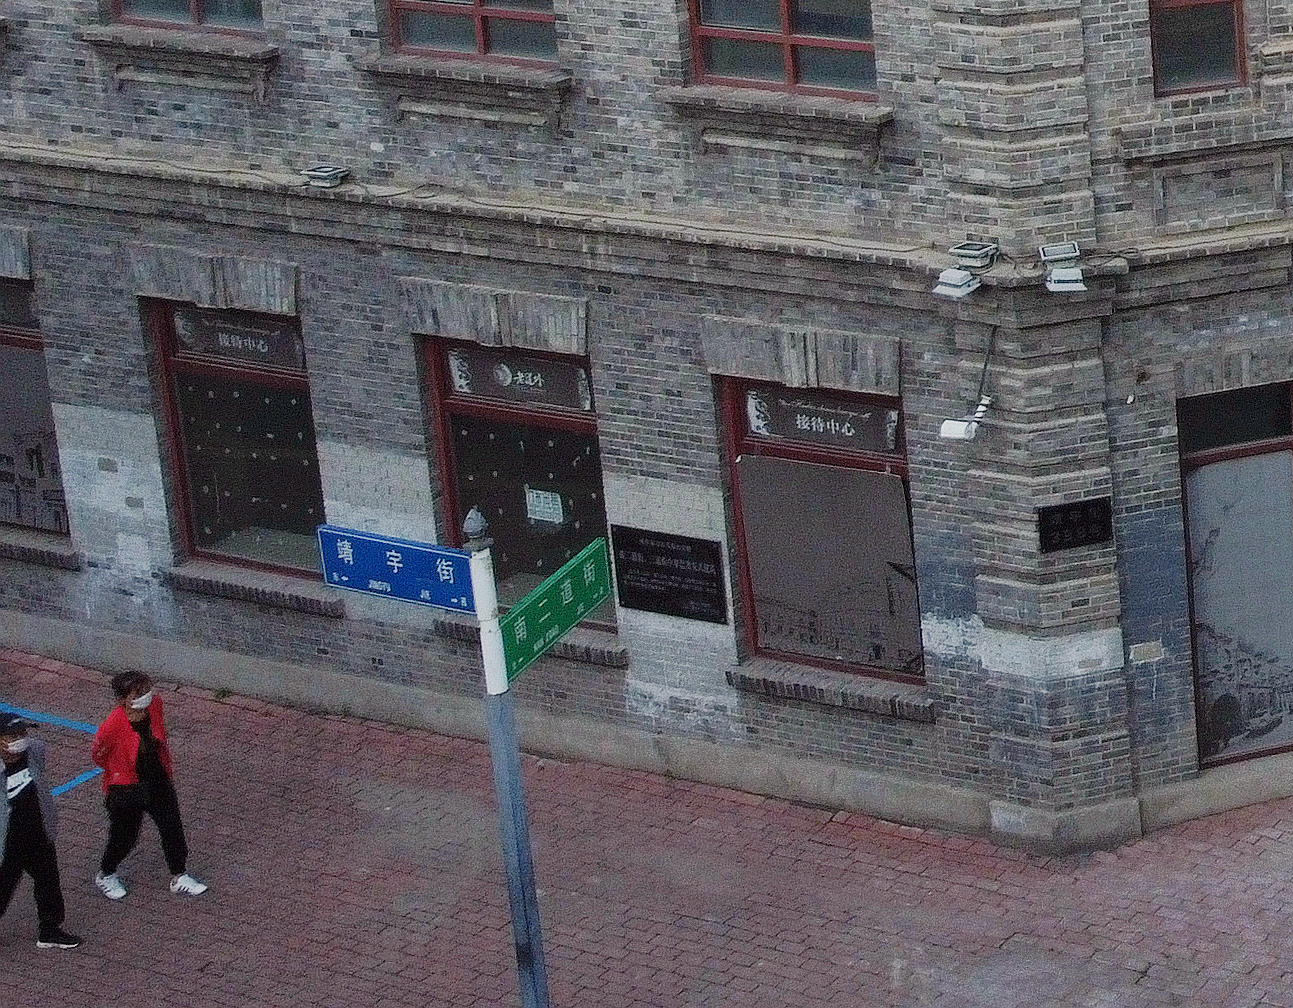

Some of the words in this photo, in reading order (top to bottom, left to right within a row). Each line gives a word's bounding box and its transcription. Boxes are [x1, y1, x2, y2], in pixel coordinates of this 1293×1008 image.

[796, 413, 856, 436] 接待中心
[337, 538, 455, 584] 靖宇街
[514, 559, 596, 644] 南二道街
